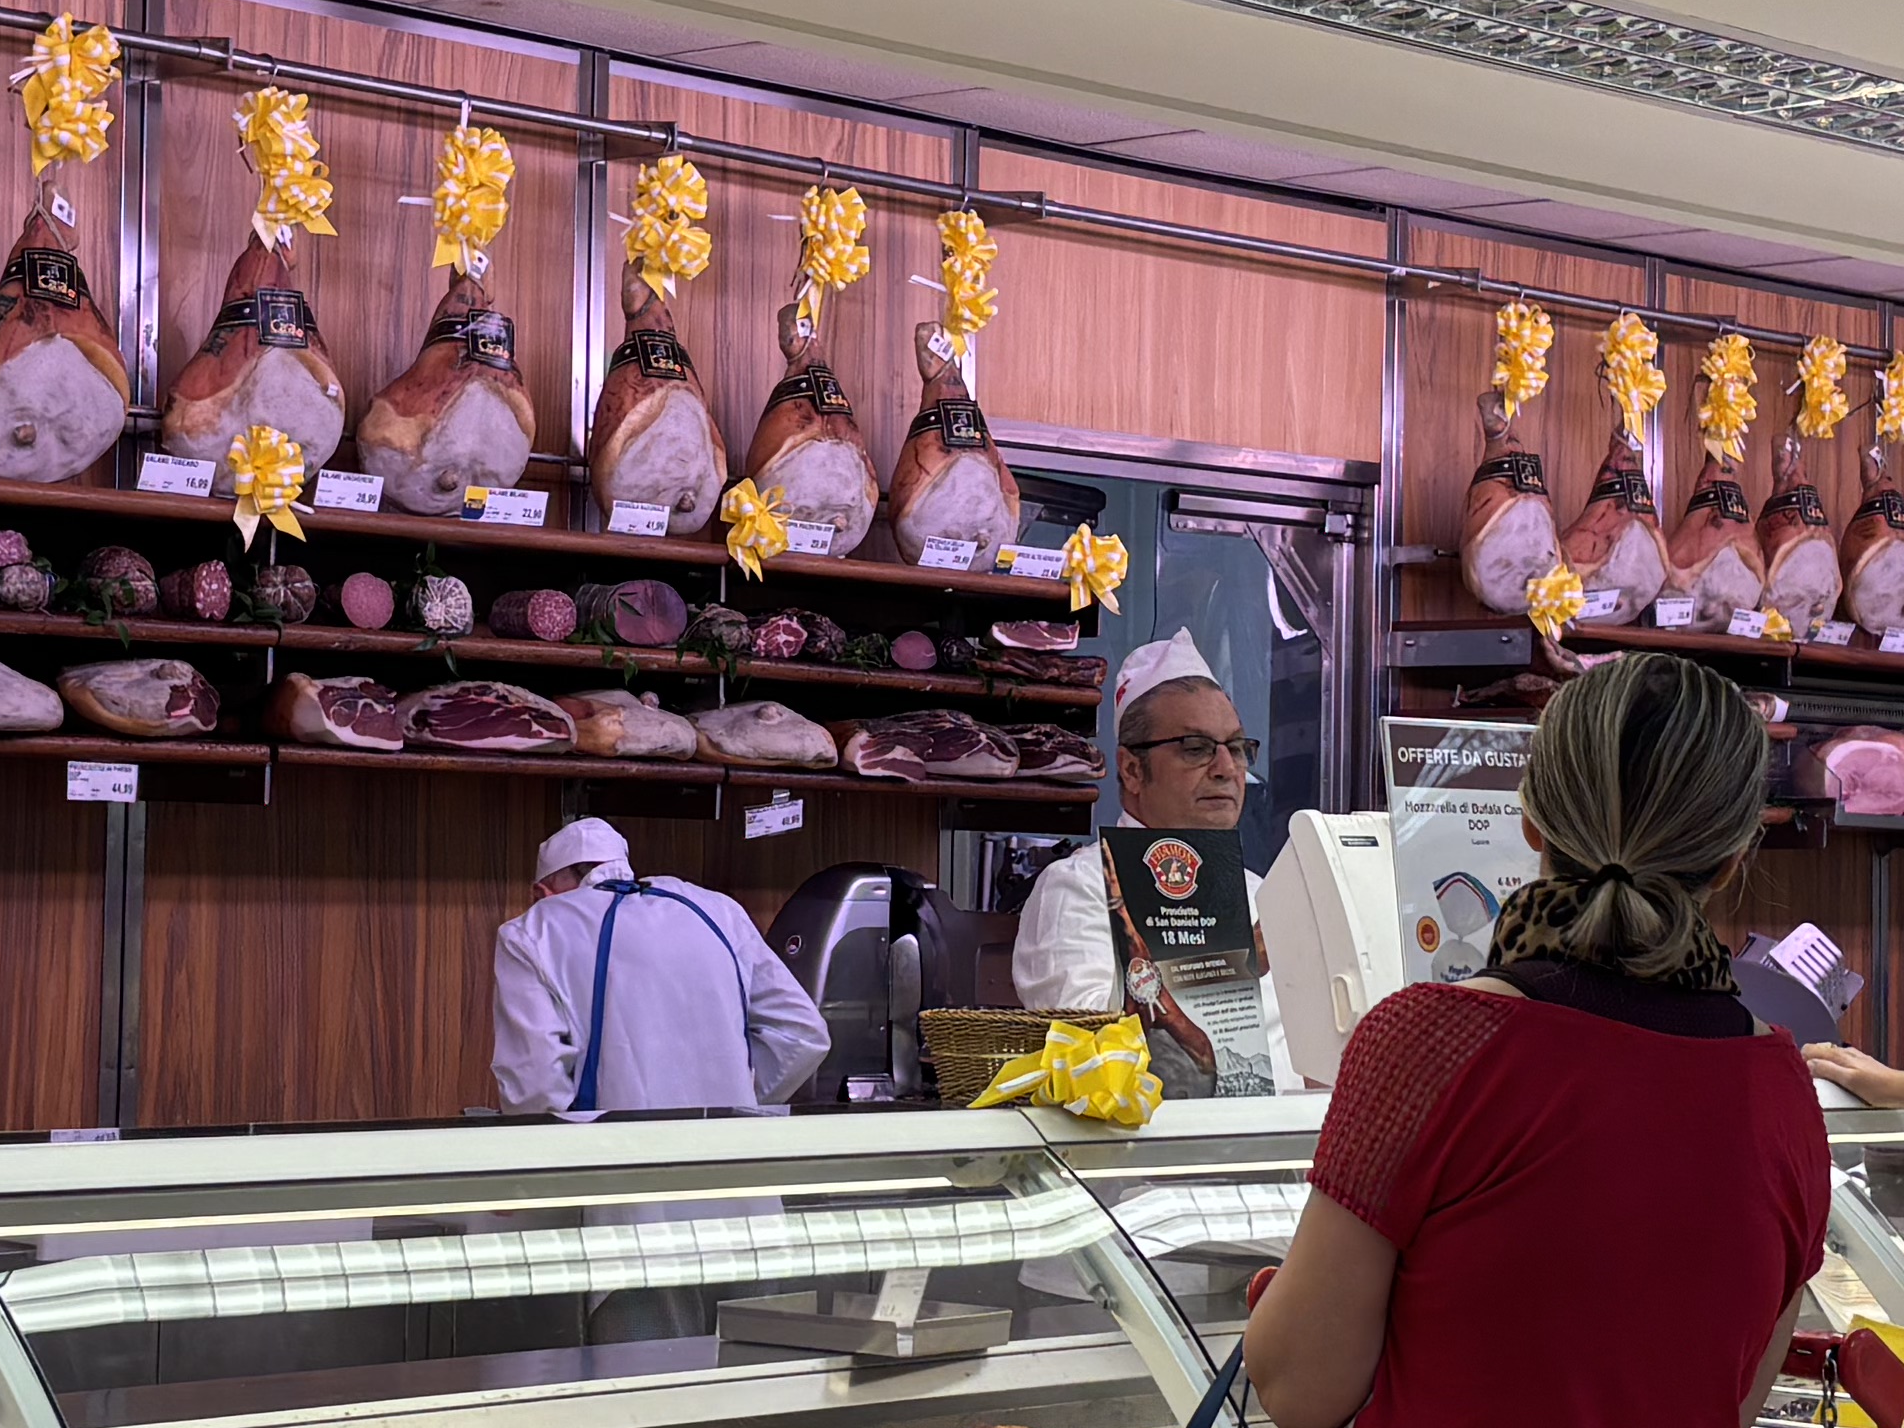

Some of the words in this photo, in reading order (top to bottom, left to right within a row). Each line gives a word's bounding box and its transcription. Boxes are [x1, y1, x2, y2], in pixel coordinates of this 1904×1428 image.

[1398, 746, 1458, 765] OFFERTE
[1463, 750, 1482, 767] DA
[1405, 801, 1457, 814] Mozzarella
[1460, 801, 1469, 814] di
[1472, 802, 1501, 815] Bufala
[1468, 819, 1490, 831] DOP
[1161, 906, 1200, 916] Prosciutto
[1155, 916, 1169, 927] San
[1170, 916, 1200, 927] Daniele
[1200, 917, 1216, 927] DOP
[1162, 931, 1176, 945] 18
[1178, 930, 1206, 945] Mesi
